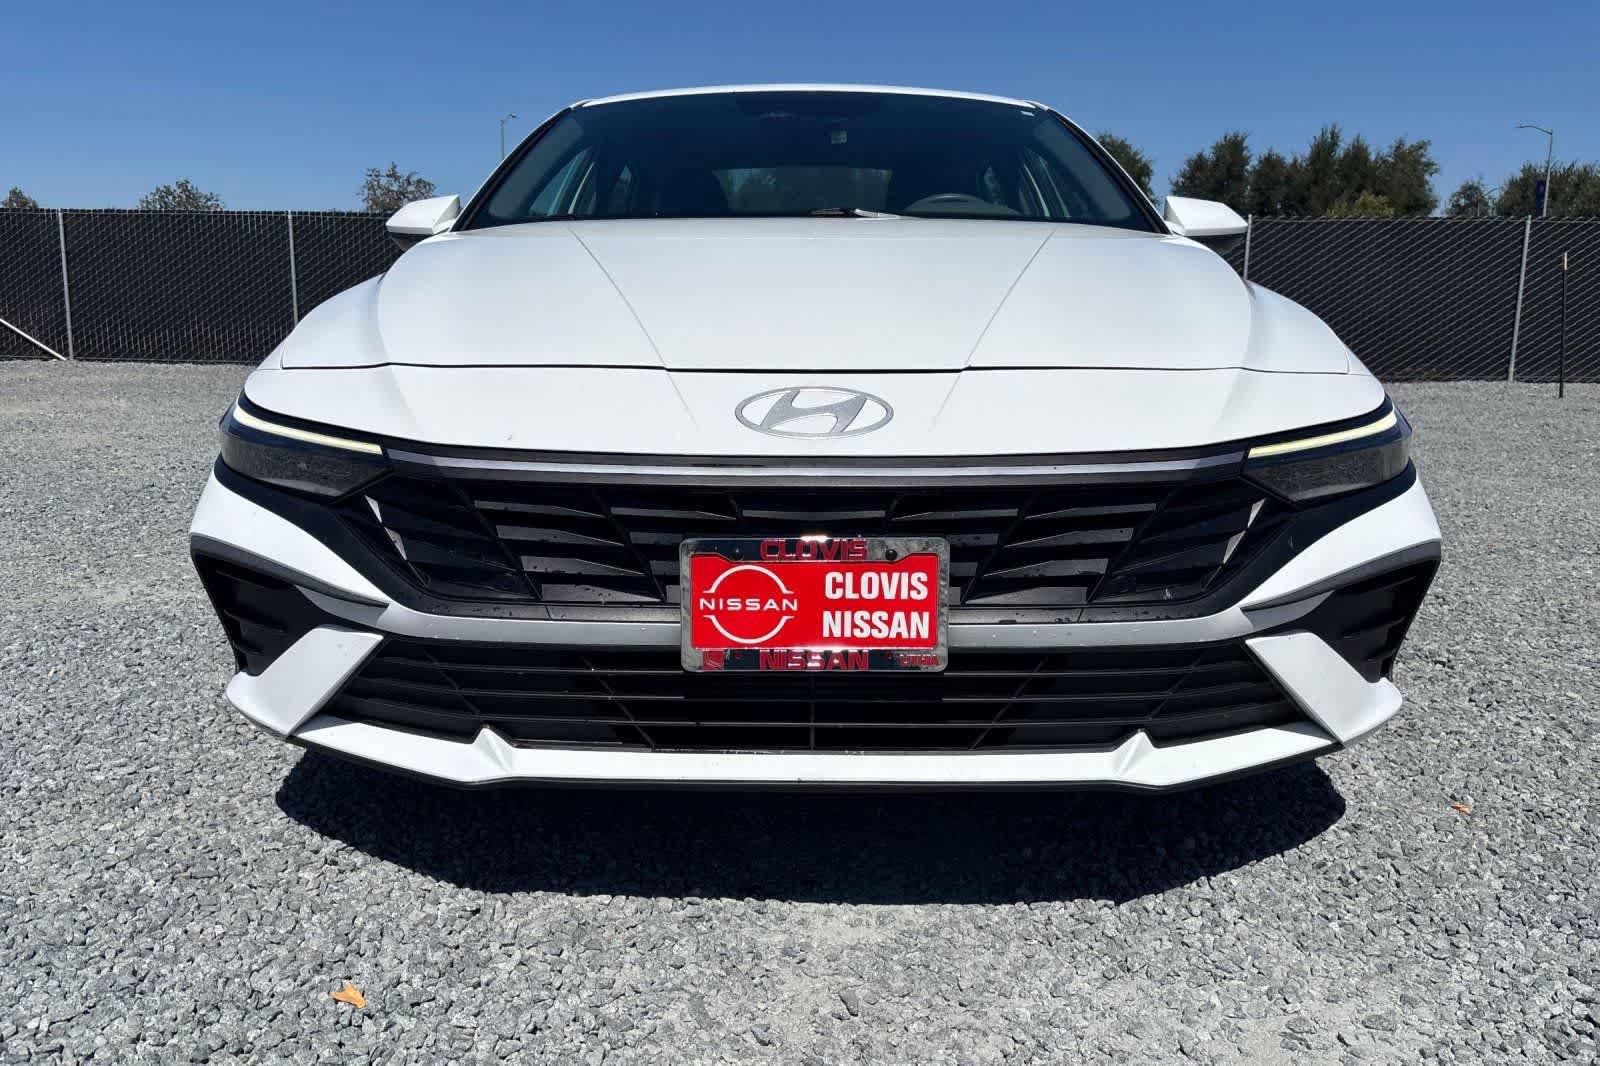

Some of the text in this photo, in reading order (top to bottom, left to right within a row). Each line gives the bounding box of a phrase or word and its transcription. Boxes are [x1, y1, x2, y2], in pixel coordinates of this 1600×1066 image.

[760, 539, 868, 560] CLOVIS
[825, 571, 928, 600] CLOVIS
[700, 598, 798, 611] NISSAN
[823, 610, 929, 638] NISSAN
[759, 649, 869, 670] NISSAN
